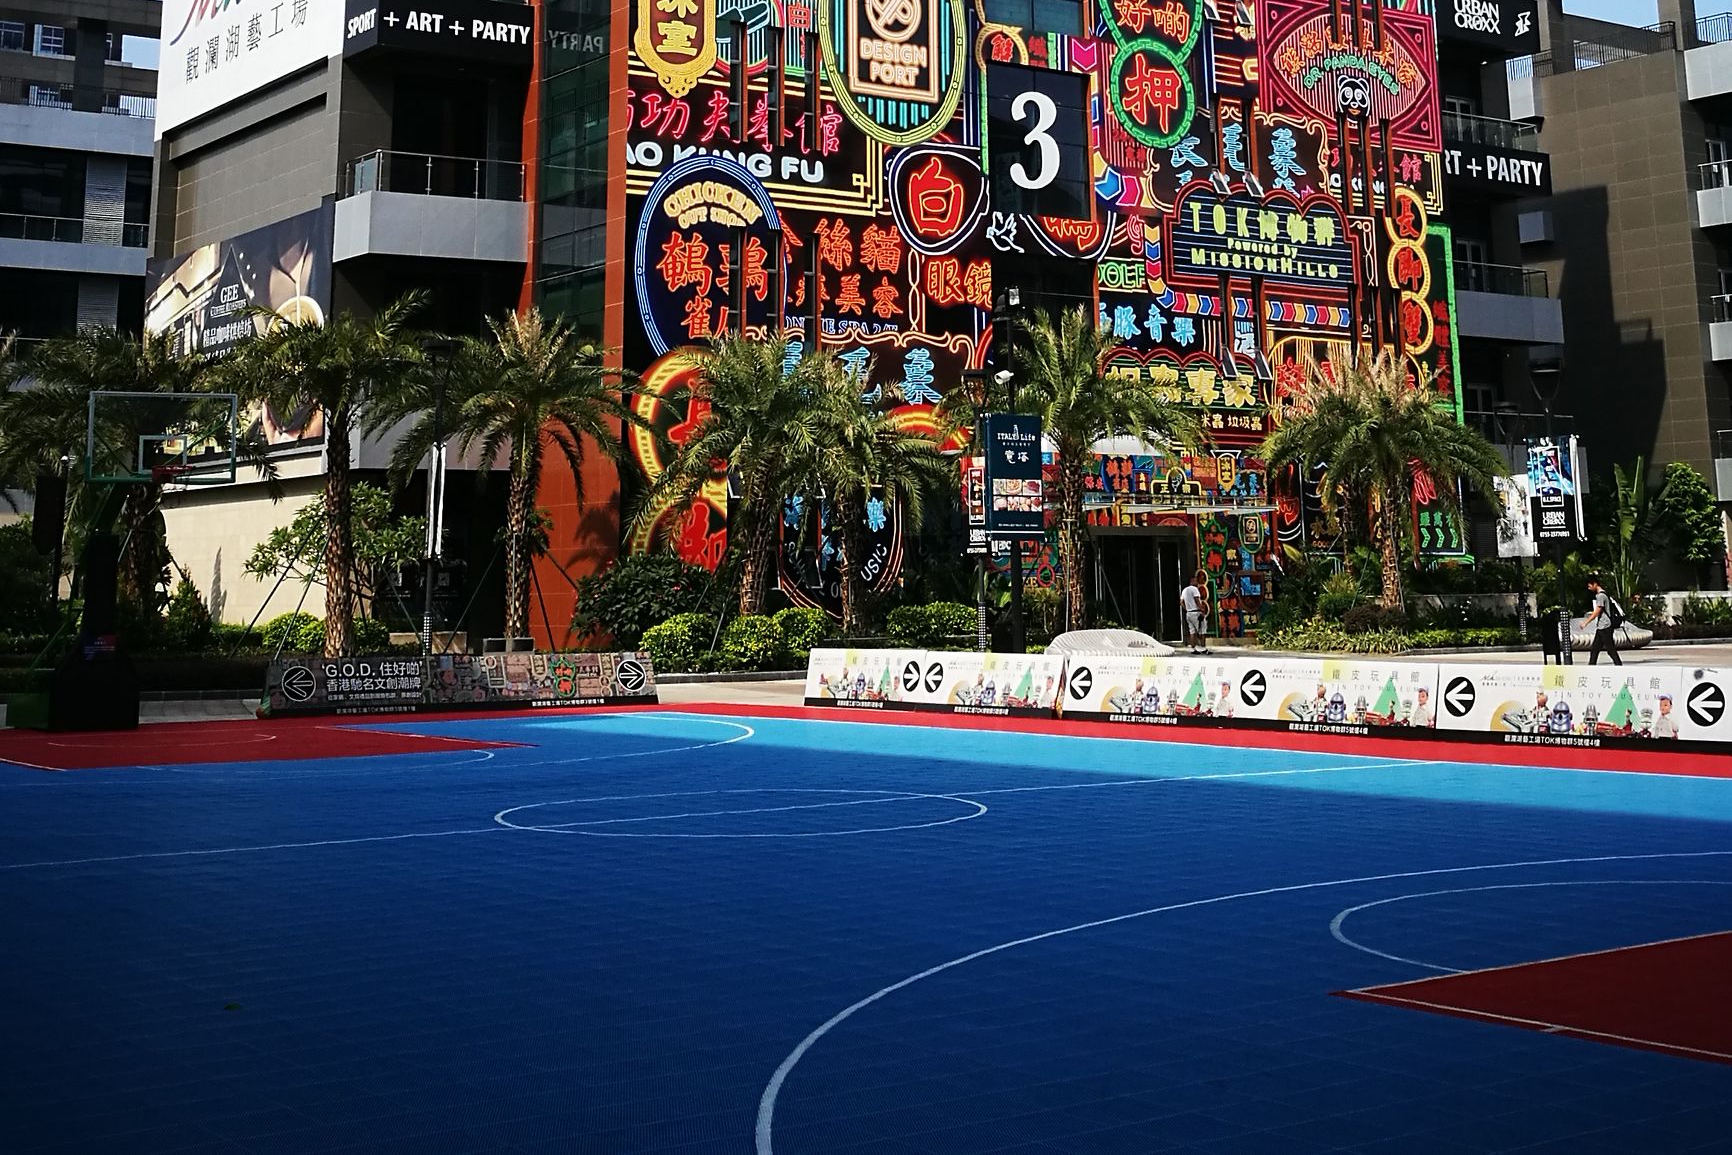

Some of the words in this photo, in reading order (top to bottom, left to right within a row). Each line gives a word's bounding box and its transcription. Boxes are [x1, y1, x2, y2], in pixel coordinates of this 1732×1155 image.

[347, 7, 376, 39] SPORT
[406, 10, 443, 33] ART
[472, 19, 530, 45] PARTY
[859, 37, 928, 68] DESIGN
[869, 63, 919, 87] PORT
[1324, 54, 1366, 71] PANDA
[1368, 61, 1399, 95] EYES
[1122, 53, 1182, 134] 押
[1009, 91, 1061, 190] 3
[781, 156, 824, 183] FU
[1486, 155, 1543, 186] PARTY
[663, 180, 763, 225] CHICKEN
[678, 207, 708, 229] OUT
[1227, 237, 1278, 255] Powered
[1283, 244, 1298, 259] by
[220, 284, 239, 304] GEE
